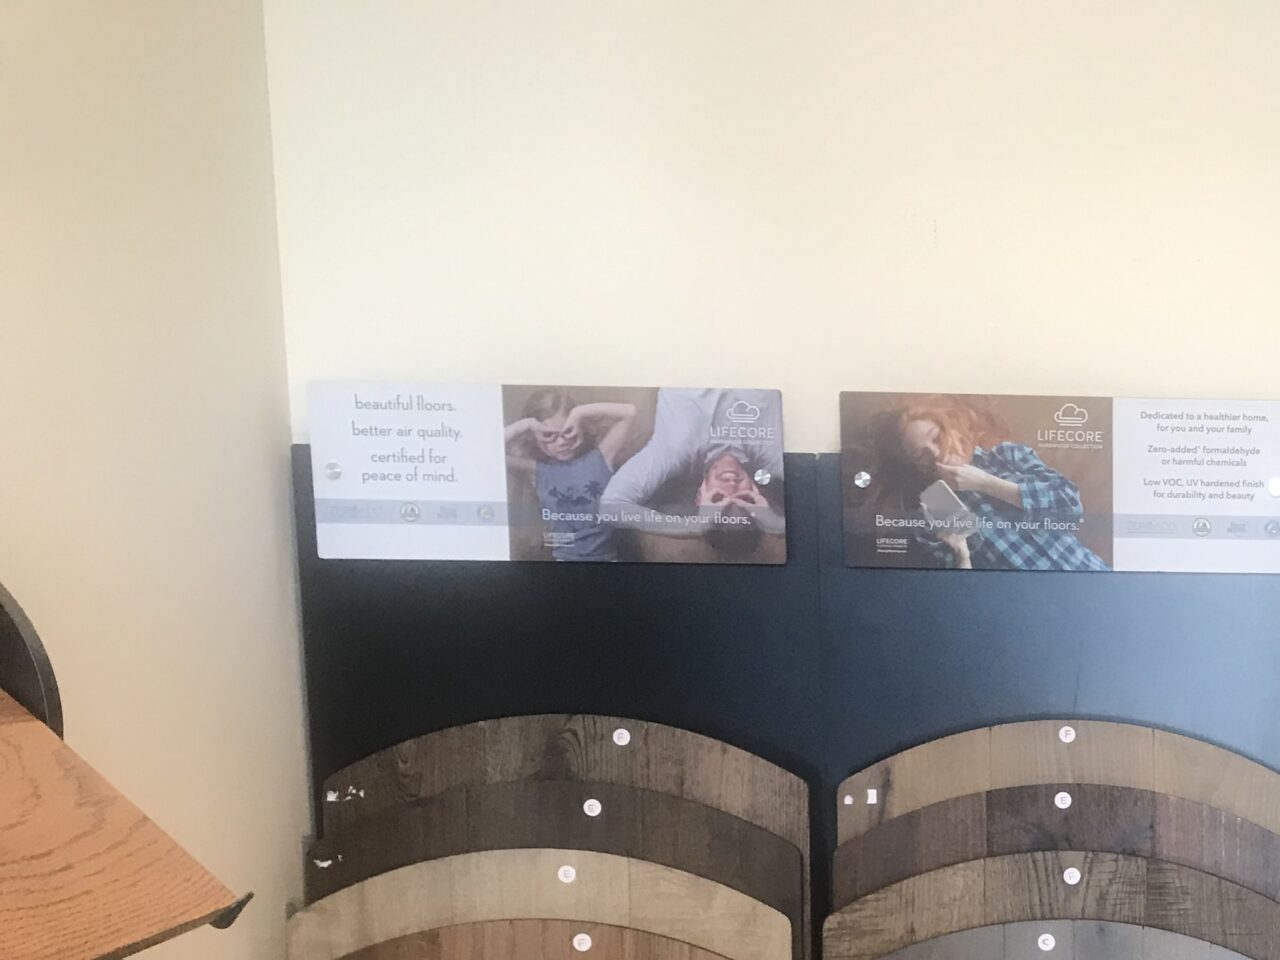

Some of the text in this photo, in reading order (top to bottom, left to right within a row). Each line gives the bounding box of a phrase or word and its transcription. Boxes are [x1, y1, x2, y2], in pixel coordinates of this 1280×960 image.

[354, 394, 456, 412] beautiful floors.
[1140, 411, 1183, 419] Dedicated
[1204, 412, 1240, 421] healthier
[1242, 413, 1269, 422] home,
[352, 420, 462, 441] better air quality.
[710, 427, 775, 439] LIFECORE
[1170, 425, 1186, 433] you
[1188, 424, 1204, 433] and
[1206, 426, 1224, 434] your
[1227, 425, 1252, 435] family
[1038, 430, 1102, 442] LIFECORE
[370, 448, 447, 464] certified for
[1203, 446, 1261, 456] formaldehyde
[1172, 458, 1204, 466] harmful
[1206, 458, 1247, 467] chemicals
[362, 466, 458, 483] peace of mind.
[1242, 480, 1264, 488] finish
[1167, 491, 1206, 501] durability
[1226, 492, 1254, 501] beauty
[542, 508, 593, 521] Because
[596, 511, 618, 525] you
[621, 510, 641, 522] live
[644, 510, 662, 523] life
[666, 514, 681, 523] on
[684, 514, 711, 526] your
[875, 515, 925, 527] Because
[928, 519, 950, 531] you
[953, 517, 973, 528] live
[976, 517, 993, 529] life
[997, 520, 1011, 529] on
[1015, 521, 1041, 532] your
